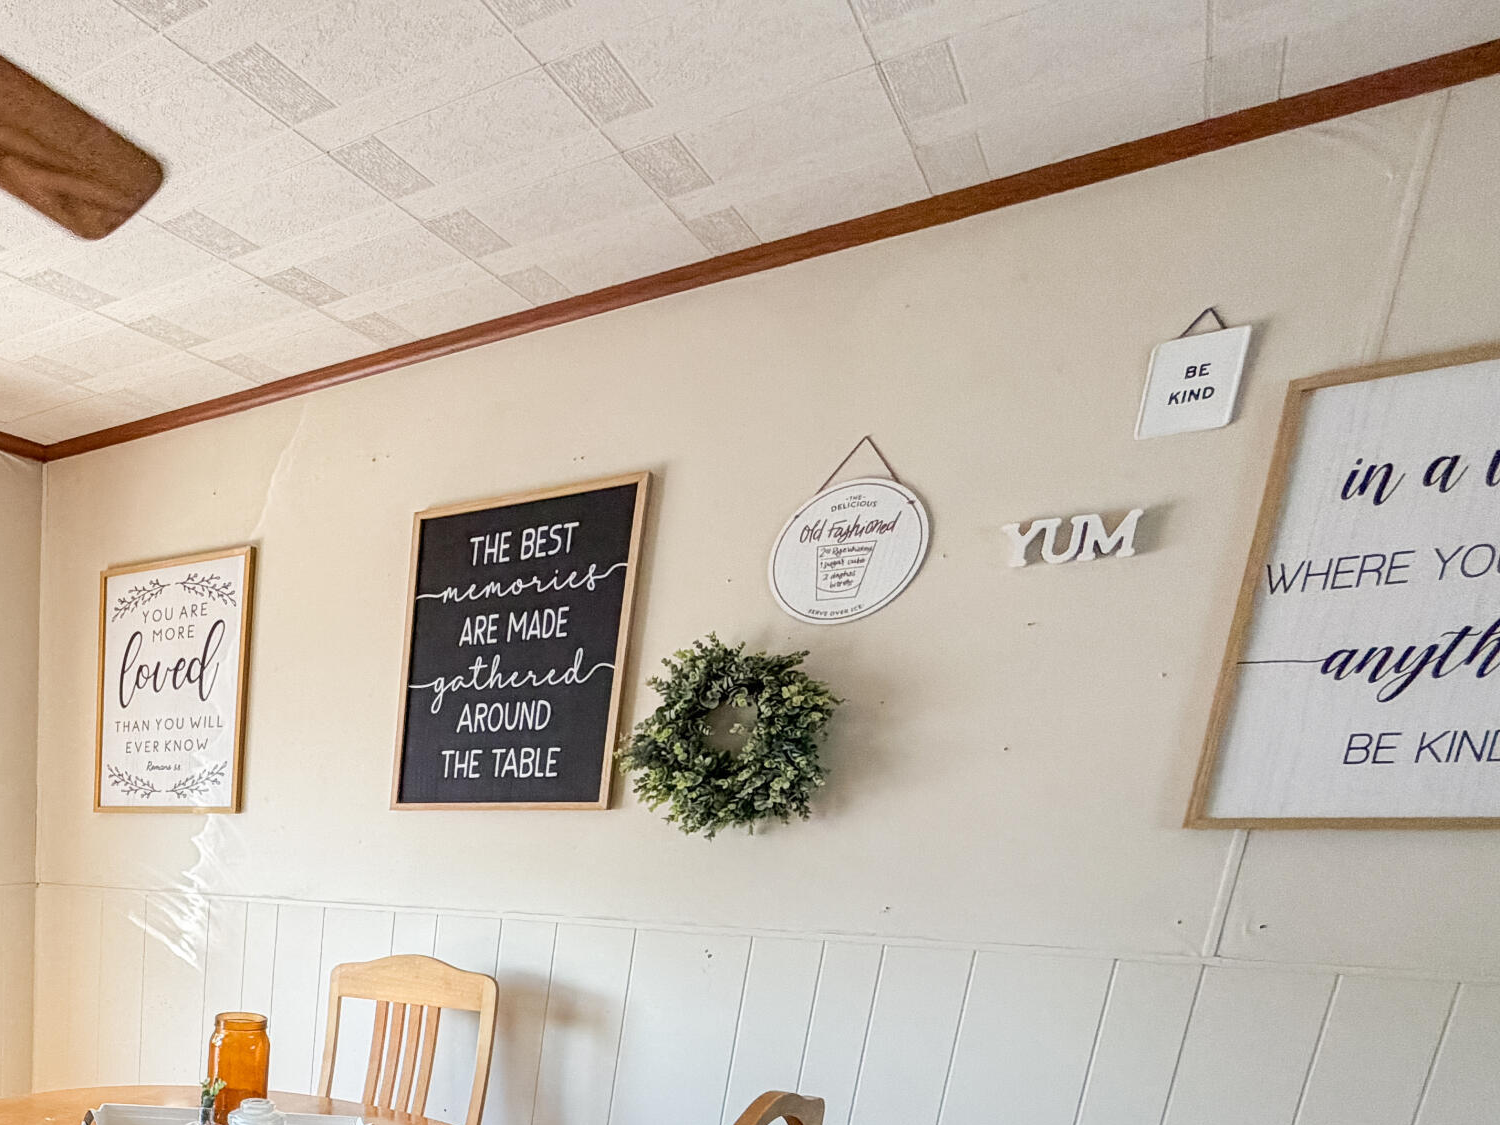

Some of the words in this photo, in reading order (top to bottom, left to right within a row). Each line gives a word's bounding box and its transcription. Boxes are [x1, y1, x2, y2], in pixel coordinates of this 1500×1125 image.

[1184, 362, 1212, 380] BE
[1167, 386, 1216, 406] KIND
[1341, 457, 1406, 506] in
[1422, 455, 1469, 493] a
[831, 500, 878, 512] DELICIOUS
[799, 518, 828, 543] Old
[828, 510, 902, 543] Fashioned
[1001, 508, 1146, 568] YUM
[470, 531, 512, 567] THE
[519, 521, 580, 561] BEST
[438, 562, 603, 604] memories
[1266, 549, 1416, 596] WHERE
[1434, 543, 1500, 580] YO
[142, 607, 174, 624] YOU
[178, 602, 208, 620] ARE
[458, 612, 500, 647] ARE
[506, 606, 570, 643] MADE
[152, 624, 196, 642] MORE
[118, 618, 226, 709] loved
[428, 647, 590, 715] gathered
[115, 719, 150, 733] THAN
[155, 717, 184, 731] YOU
[190, 714, 223, 729] WILL
[456, 699, 551, 734] AROUND
[125, 740, 160, 754] EVER
[164, 738, 209, 753] KNOW
[1343, 732, 1404, 765] BE
[441, 749, 483, 779] THE
[491, 747, 561, 778] TABLE
